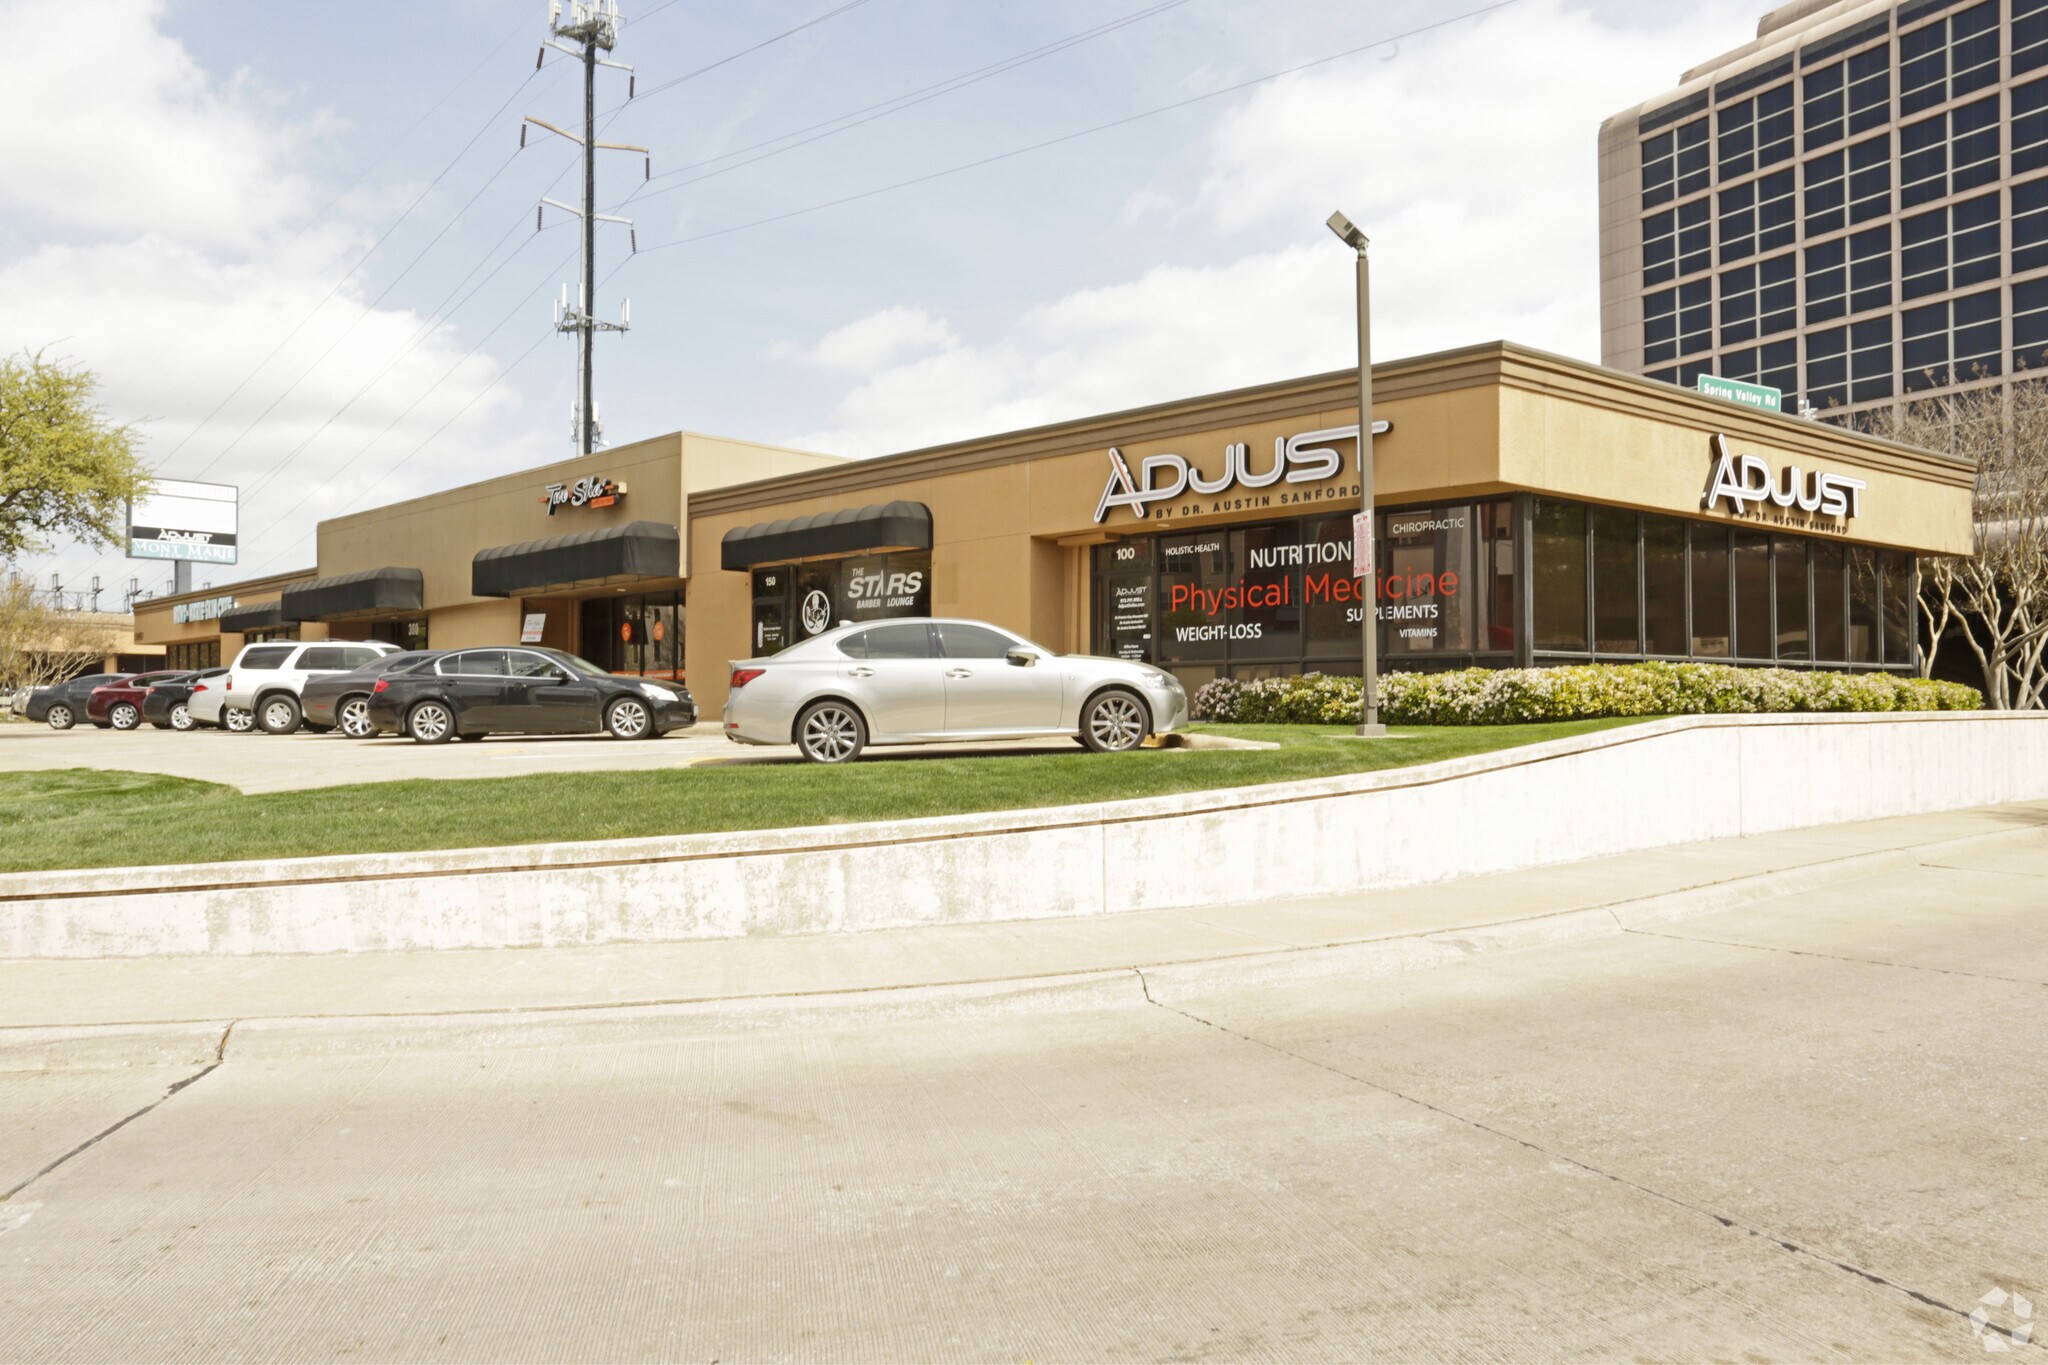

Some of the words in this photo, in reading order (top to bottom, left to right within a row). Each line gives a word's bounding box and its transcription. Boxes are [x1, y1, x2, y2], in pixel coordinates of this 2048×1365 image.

[1704, 383, 1733, 400] Spring
[1736, 388, 1762, 406] Valley
[1765, 394, 1776, 407] Rd
[1094, 420, 1391, 523] ADJUST
[1702, 433, 1867, 518] ADJUST
[1156, 507, 1173, 519] BY
[1182, 504, 1204, 516] DR.
[1213, 495, 1271, 513] AUSTIN
[1281, 484, 1361, 505] SANFORD
[1392, 517, 1465, 534] CHIROPRACTIC
[1773, 514, 1806, 528] AUSTIN
[1809, 520, 1847, 535] SANFORD
[157, 528, 213, 542] ADJUST
[134, 541, 181, 555] MONT
[187, 544, 235, 560] MARIE
[1116, 547, 1135, 560] 100
[1165, 544, 1193, 556] HOLISTIC
[1195, 542, 1220, 554] HEALTH
[1250, 541, 1352, 569] NUTRITION
[765, 576, 776, 587] 150
[852, 567, 865, 577] THE
[847, 568, 923, 599] STARS
[856, 598, 881, 609] BARBER
[886, 595, 914, 608] LOUNGE
[1171, 575, 1289, 616] Physical
[1346, 604, 1438, 622] SULEMENTS
[1176, 623, 1262, 643] WEIGHT-LOSS
[1399, 627, 1438, 639] VITAMINS
